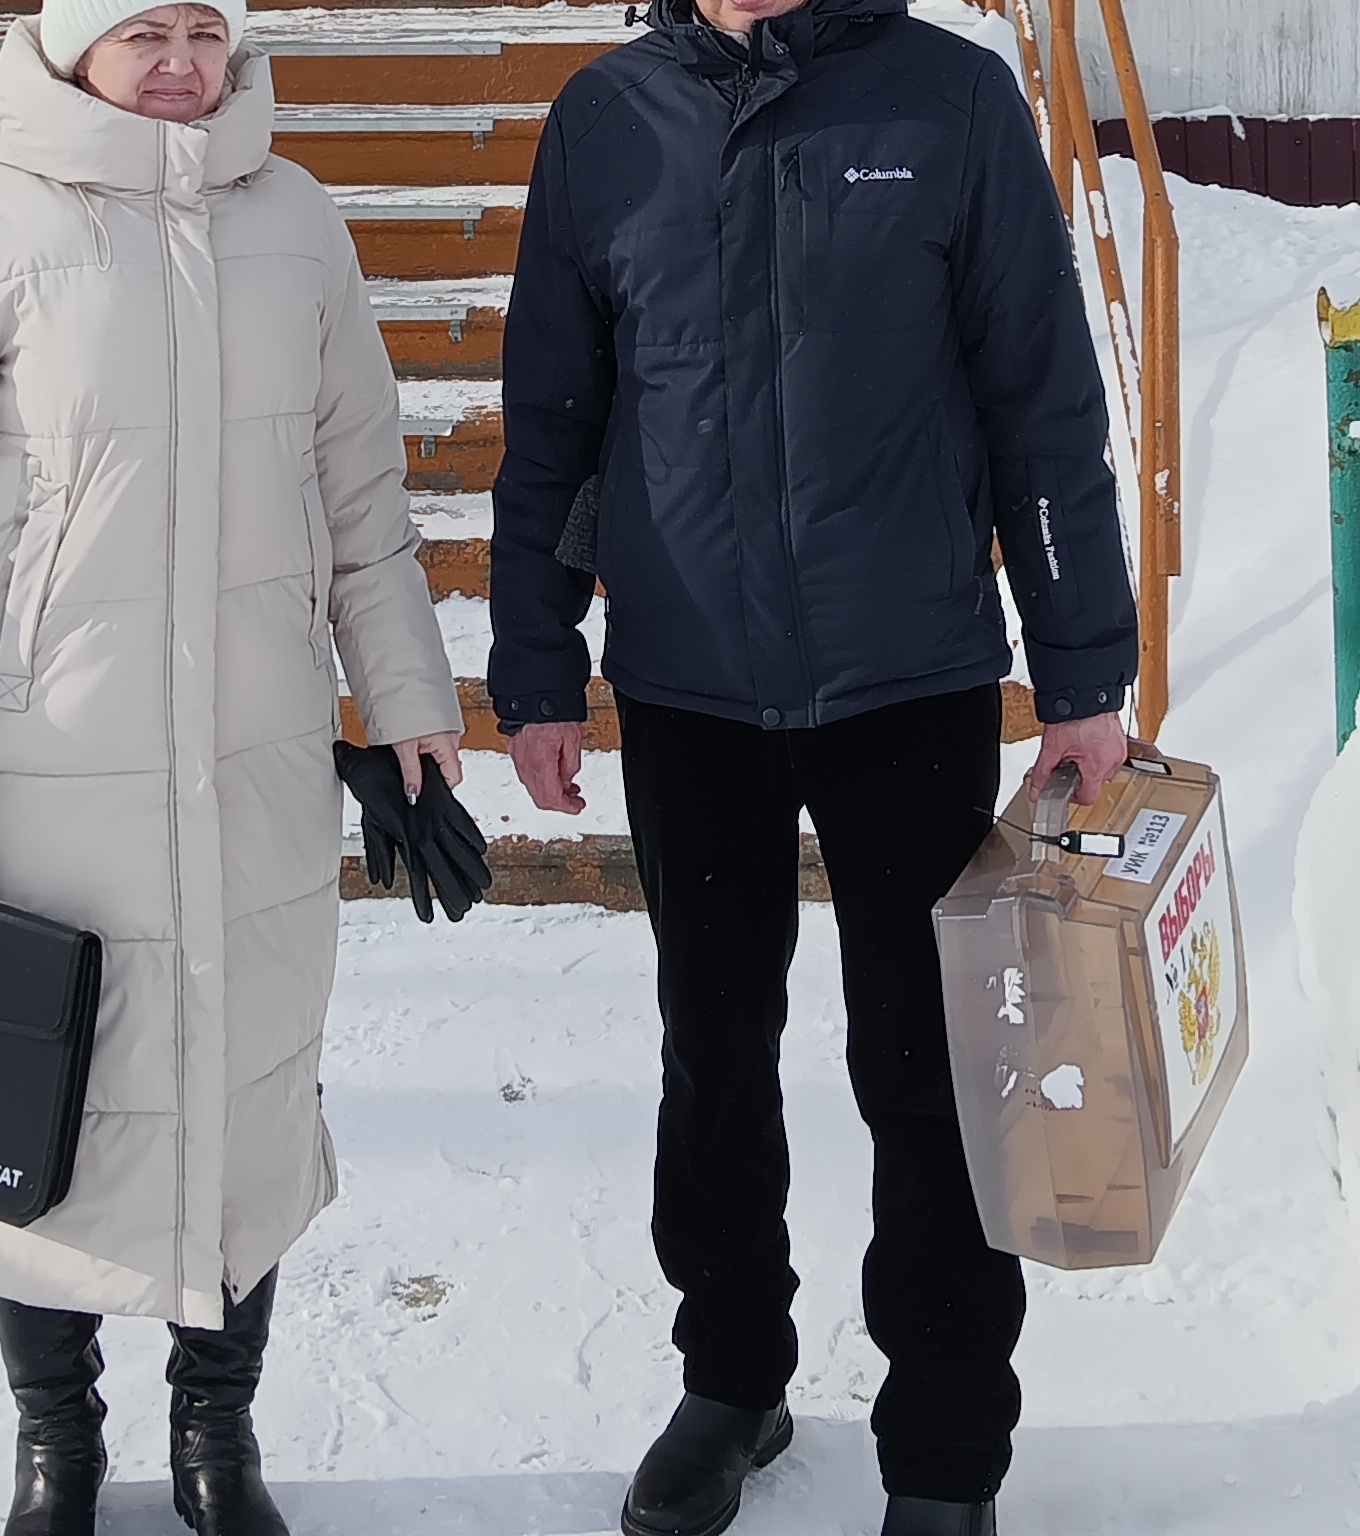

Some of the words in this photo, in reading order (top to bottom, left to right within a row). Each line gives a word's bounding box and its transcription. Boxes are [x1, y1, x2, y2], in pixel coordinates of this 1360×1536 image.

[860, 167, 915, 181] Columbia
[1121, 849, 1149, 875] УИК
[1158, 830, 1216, 965] ВЫБОРЫ
